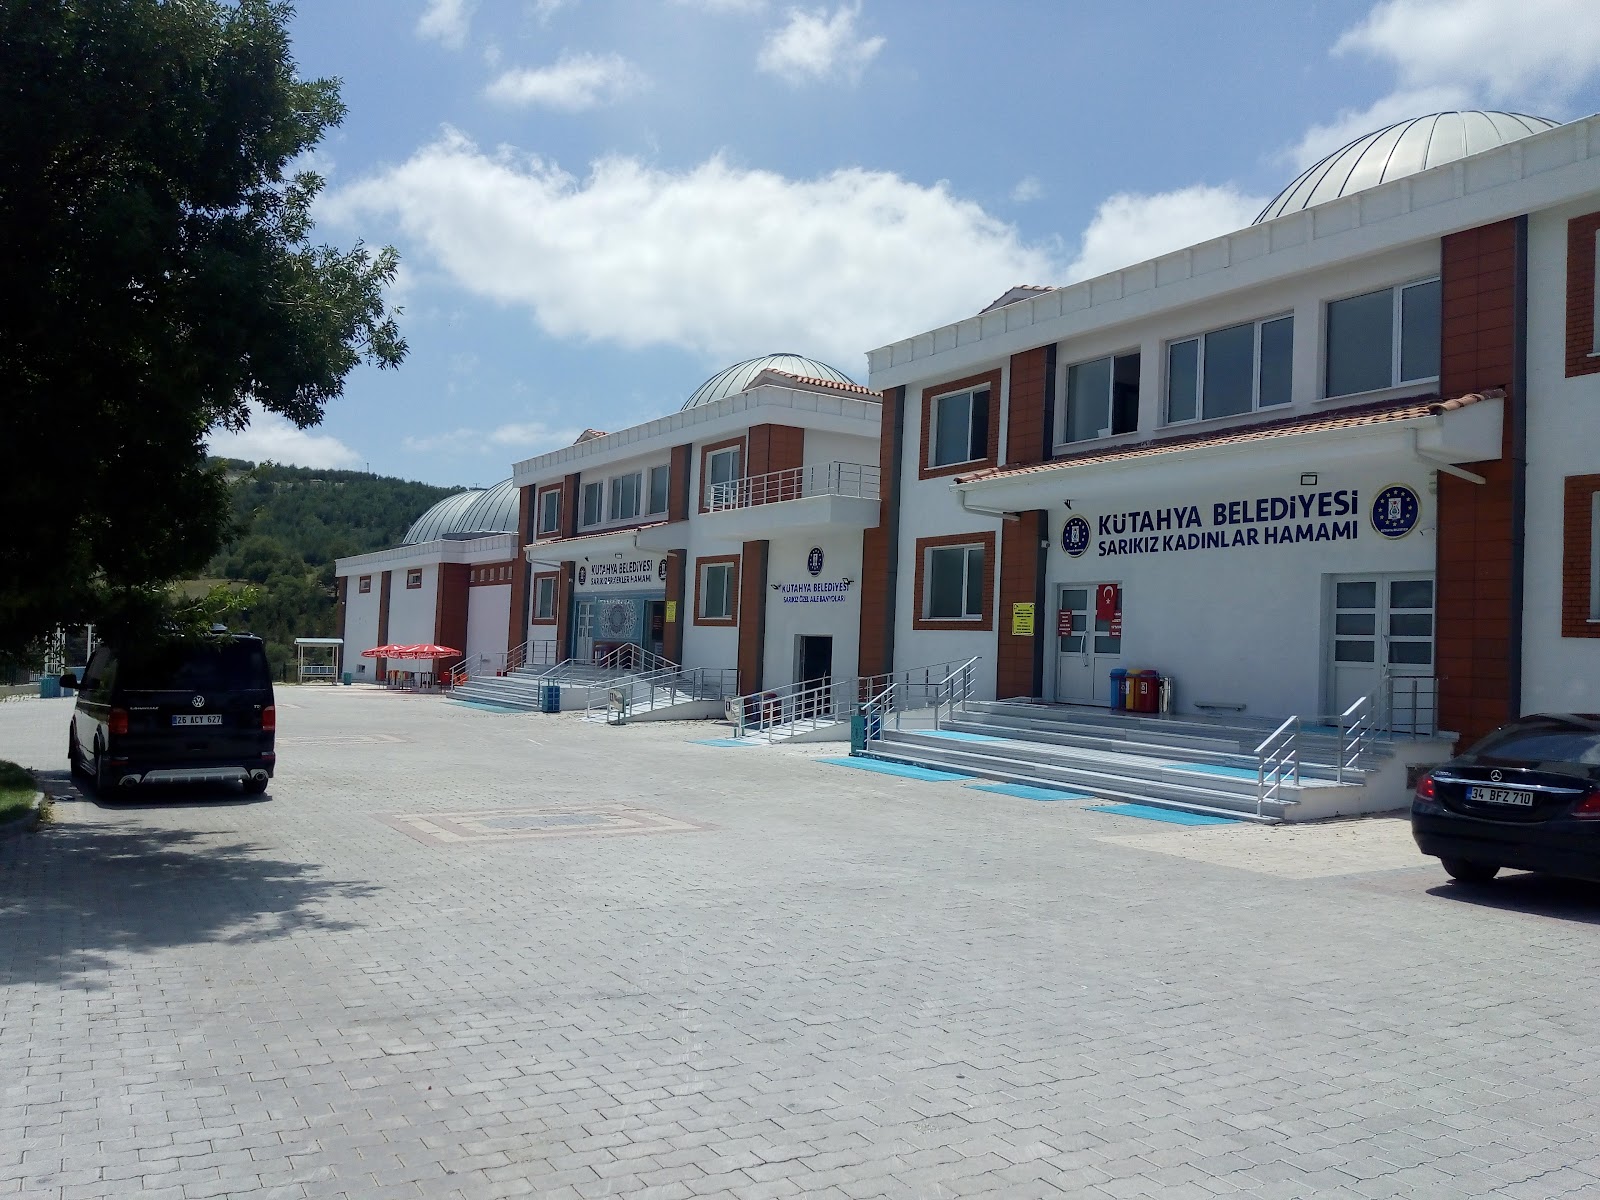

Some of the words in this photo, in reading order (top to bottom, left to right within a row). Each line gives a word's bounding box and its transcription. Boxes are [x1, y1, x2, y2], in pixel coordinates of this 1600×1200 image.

[1098, 505, 1202, 536] KÜTAHYA
[1098, 536, 1159, 557] SARIKIZ
[1162, 528, 1260, 552] KADINLAR
[1264, 520, 1358, 545] HAMAMI
[177, 715, 187, 724] 26
[190, 715, 203, 724] ACY
[207, 715, 221, 724] 627
[1472, 788, 1484, 800] 34
[1489, 790, 1510, 803] BFZ
[1513, 792, 1531, 805] 710
